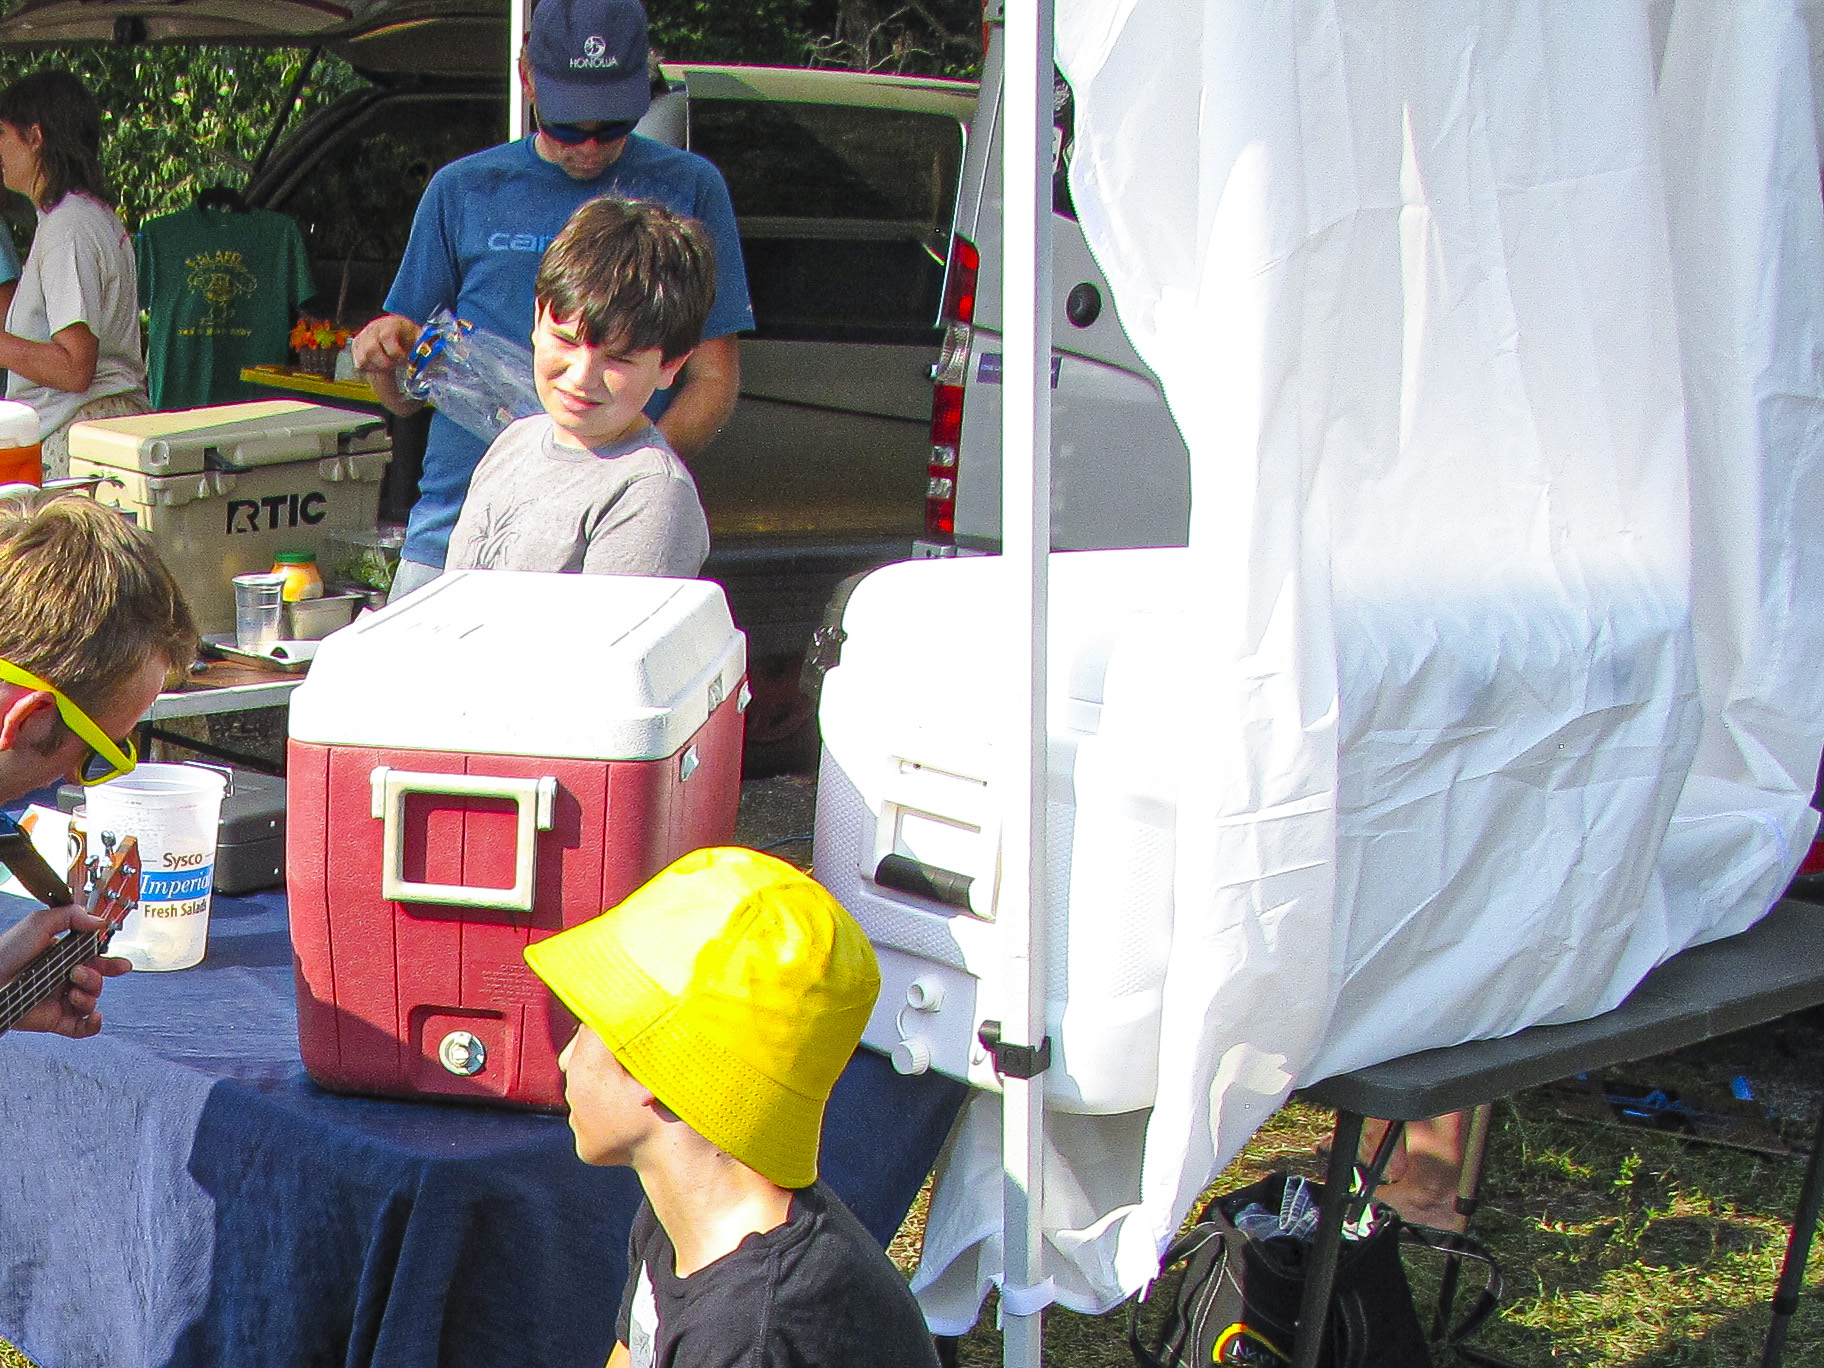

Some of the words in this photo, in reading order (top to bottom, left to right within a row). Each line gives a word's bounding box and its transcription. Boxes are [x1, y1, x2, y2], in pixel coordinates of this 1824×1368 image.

[226, 491, 328, 535] RTIC
[163, 852, 203, 871] Sysco
[144, 903, 178, 919] Fresh
[180, 898, 207, 917] Salads
